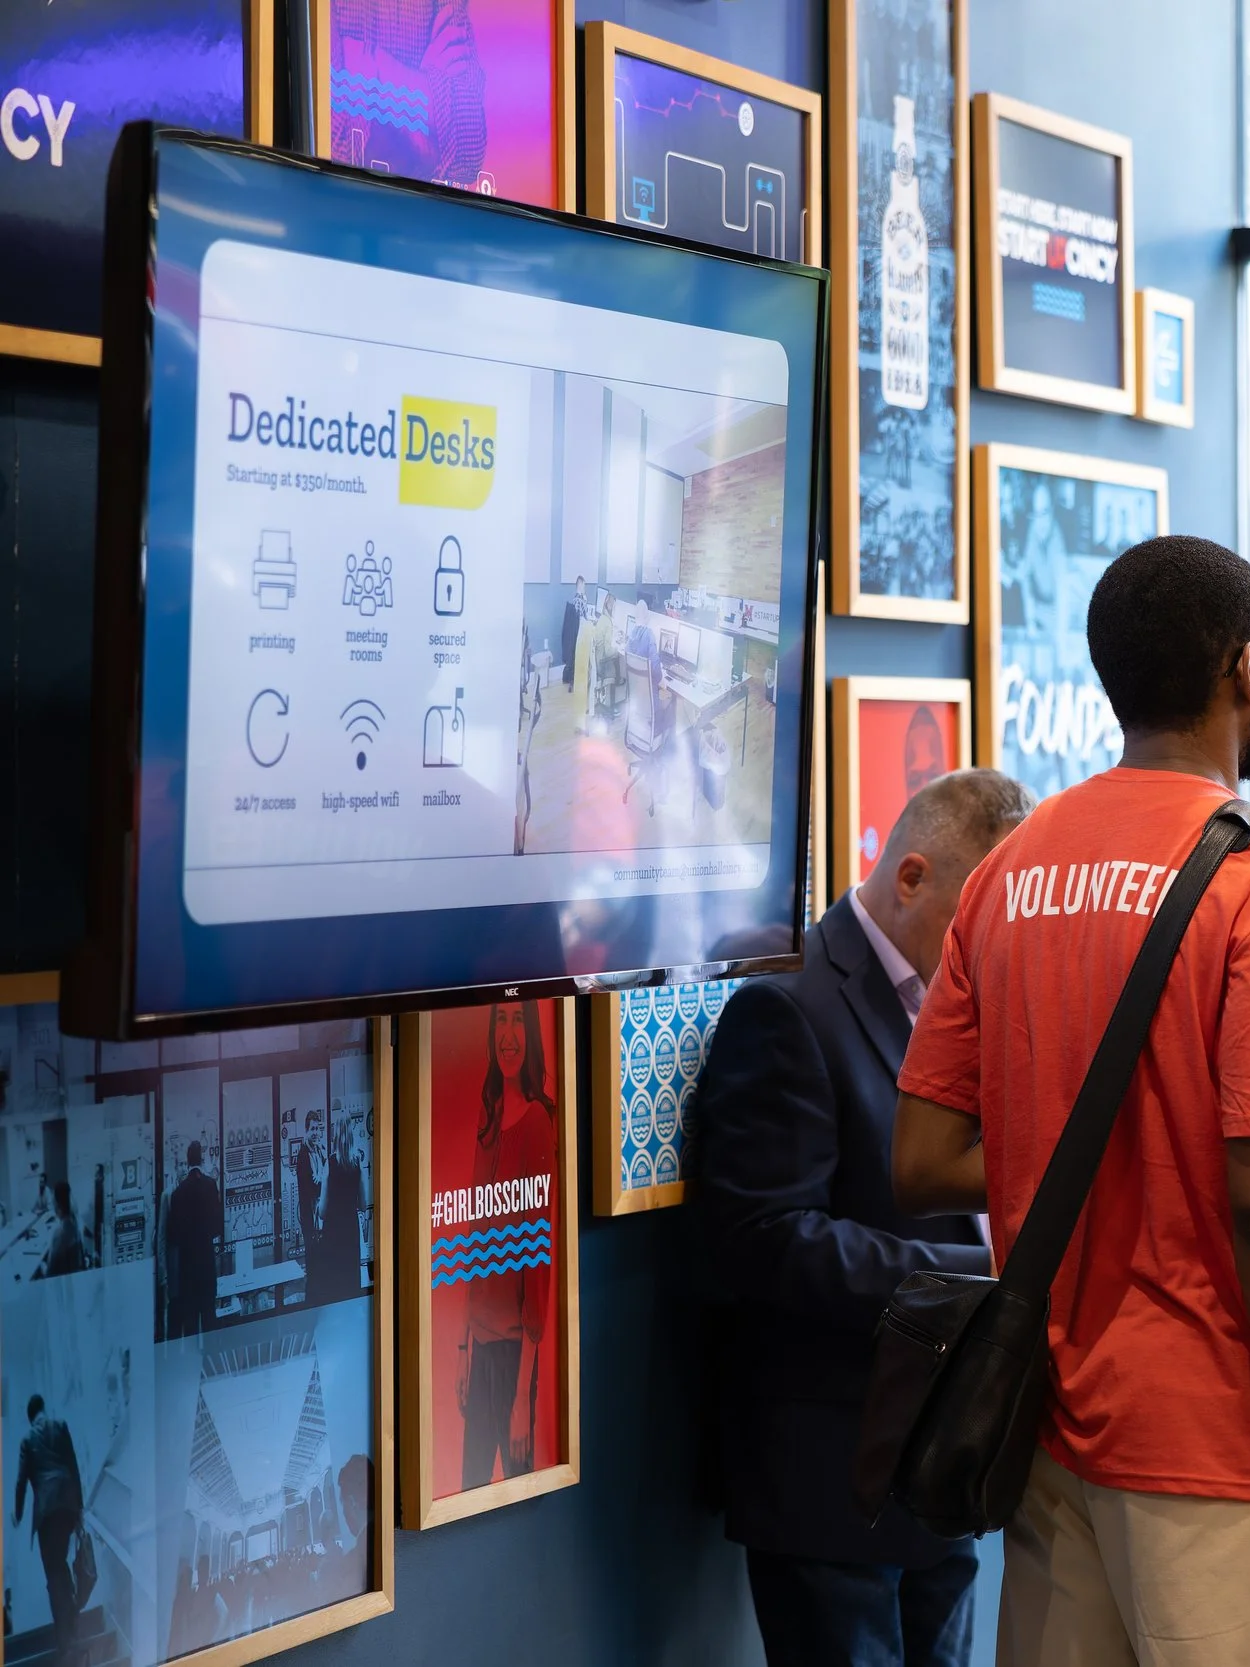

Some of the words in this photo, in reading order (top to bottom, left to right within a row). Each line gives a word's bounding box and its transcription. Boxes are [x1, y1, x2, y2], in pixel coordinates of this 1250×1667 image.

[227, 391, 397, 460] Dedicated
[405, 414, 495, 470] Desks
[226, 463, 277, 490] Starting
[280, 468, 292, 486] at
[295, 471, 367, 494] $350/month.
[249, 632, 296, 654] printing
[345, 627, 388, 648] meeting
[428, 631, 466, 647] secured
[350, 648, 382, 662] rooms
[433, 651, 461, 668] space
[234, 795, 259, 814] 24/7
[261, 798, 296, 811] access
[321, 791, 378, 814] high-speed
[380, 791, 399, 807] wifi
[422, 790, 461, 807] mailbox
[504, 987, 519, 997] NEC
[431, 1173, 551, 1228] #GIRLBOSSCINCY
